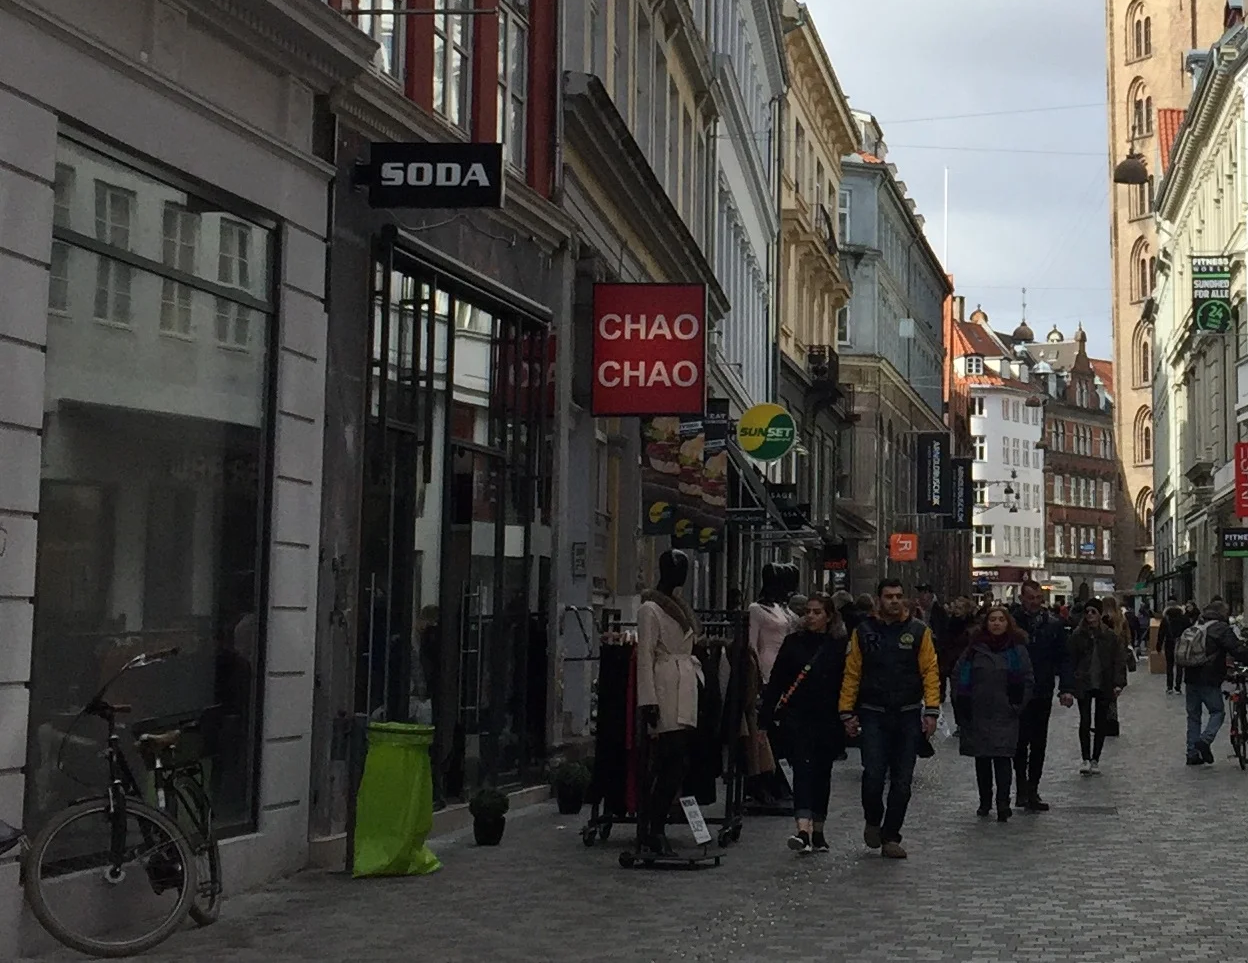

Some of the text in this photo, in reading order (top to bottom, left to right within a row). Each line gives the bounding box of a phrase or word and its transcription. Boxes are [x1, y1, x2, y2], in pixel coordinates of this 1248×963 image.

[381, 162, 491, 186] SODA
[1192, 258, 1229, 266] FITNESS
[1194, 289, 1229, 298] FOR ALLE
[598, 313, 699, 340] CHAO
[598, 360, 699, 387] CHAO
[740, 427, 794, 437] SUNSET
